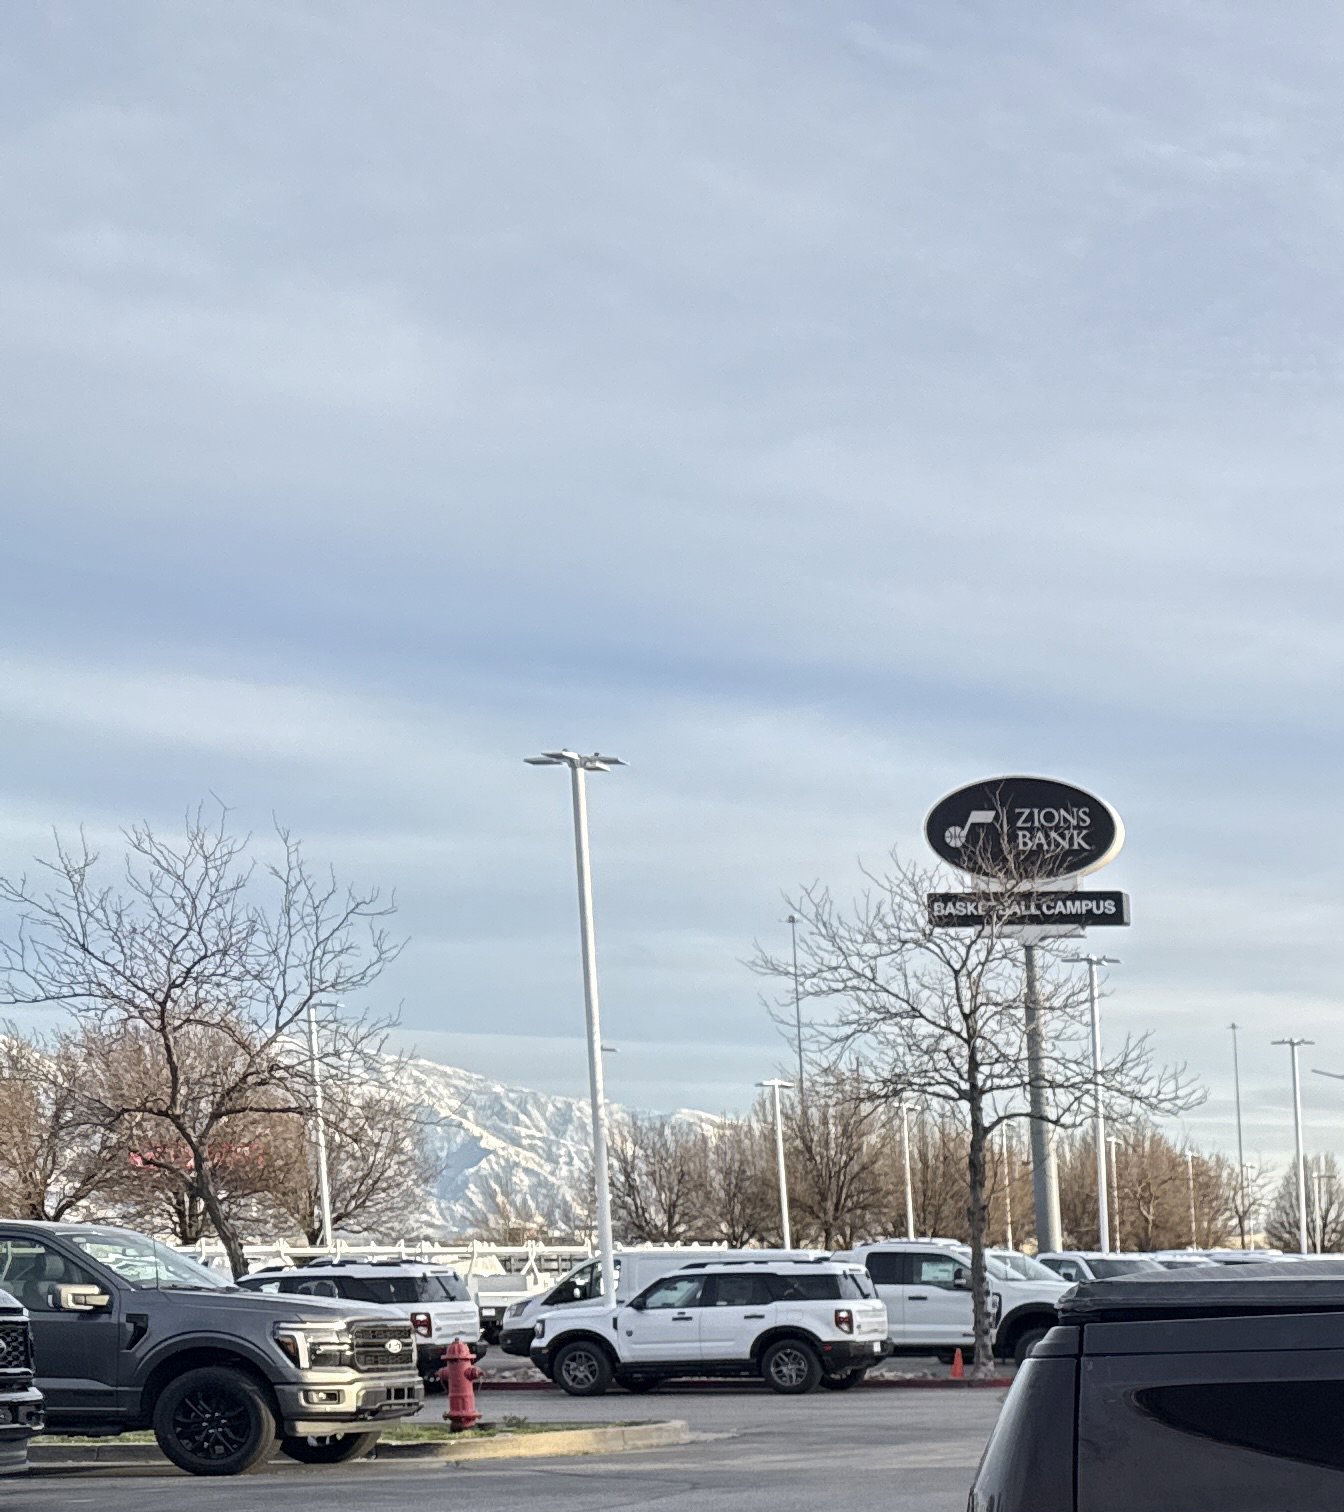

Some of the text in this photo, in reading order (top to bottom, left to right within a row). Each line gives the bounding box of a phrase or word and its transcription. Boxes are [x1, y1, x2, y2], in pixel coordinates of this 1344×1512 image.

[1014, 807, 1091, 827] ZIONS
[1016, 829, 1092, 850] BANK
[933, 900, 1116, 916] BASKEBALL CAMPUS
